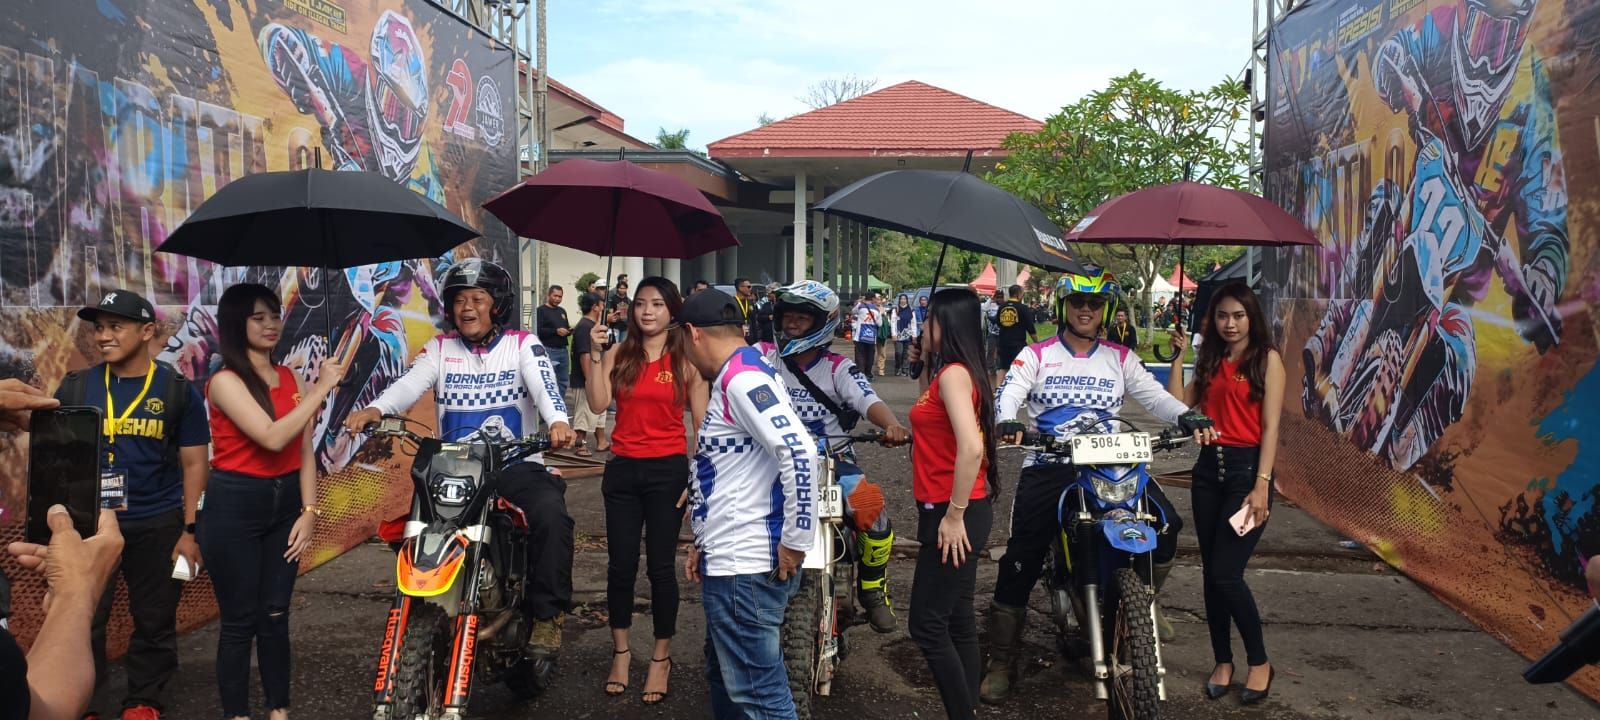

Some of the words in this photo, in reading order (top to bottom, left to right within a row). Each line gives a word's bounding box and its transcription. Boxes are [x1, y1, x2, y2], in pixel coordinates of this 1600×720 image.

[1338, 4, 1383, 43] PRESISI
[445, 372, 497, 385] BORNEO
[498, 369, 516, 382] 86
[1044, 375, 1096, 387] BORNEO
[1098, 378, 1116, 389] 86
[1073, 438, 1082, 449] P
[1091, 436, 1121, 449] 5084
[1133, 435, 1148, 447] GT
[374, 608, 400, 692] Husqvarna
[457, 614, 478, 697] Husqvarna
